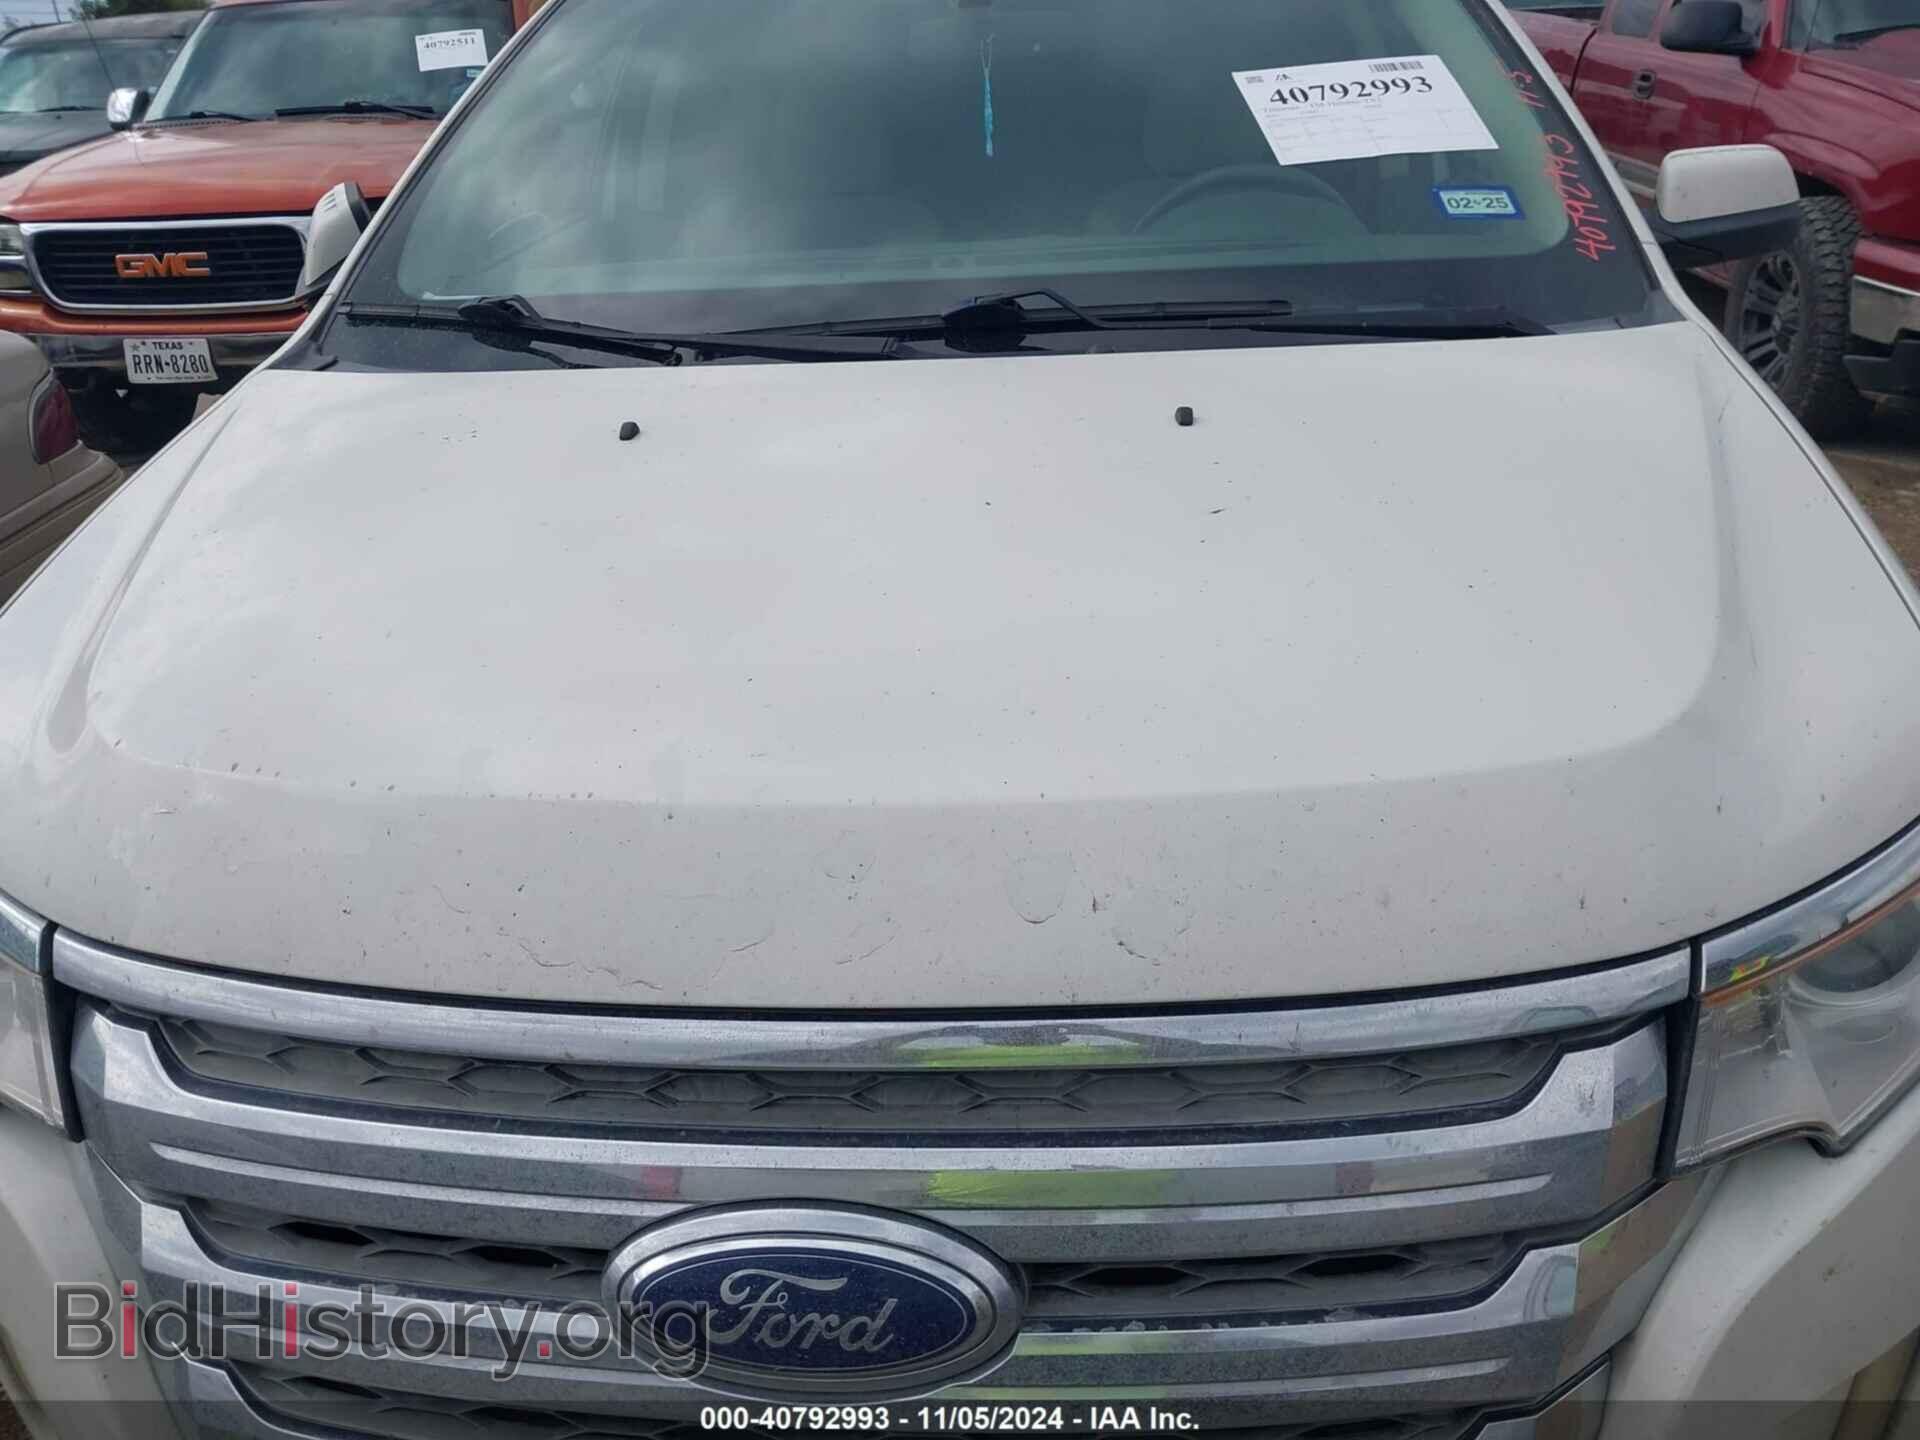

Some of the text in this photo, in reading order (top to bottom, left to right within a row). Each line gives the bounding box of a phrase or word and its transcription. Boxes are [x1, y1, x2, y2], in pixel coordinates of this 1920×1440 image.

[1269, 76, 1433, 105] 40792993
[115, 252, 210, 278] GMC
[152, 341, 183, 350] TEXAS
[132, 354, 209, 374] RRN-8280
[707, 1268, 898, 1351] Ford
